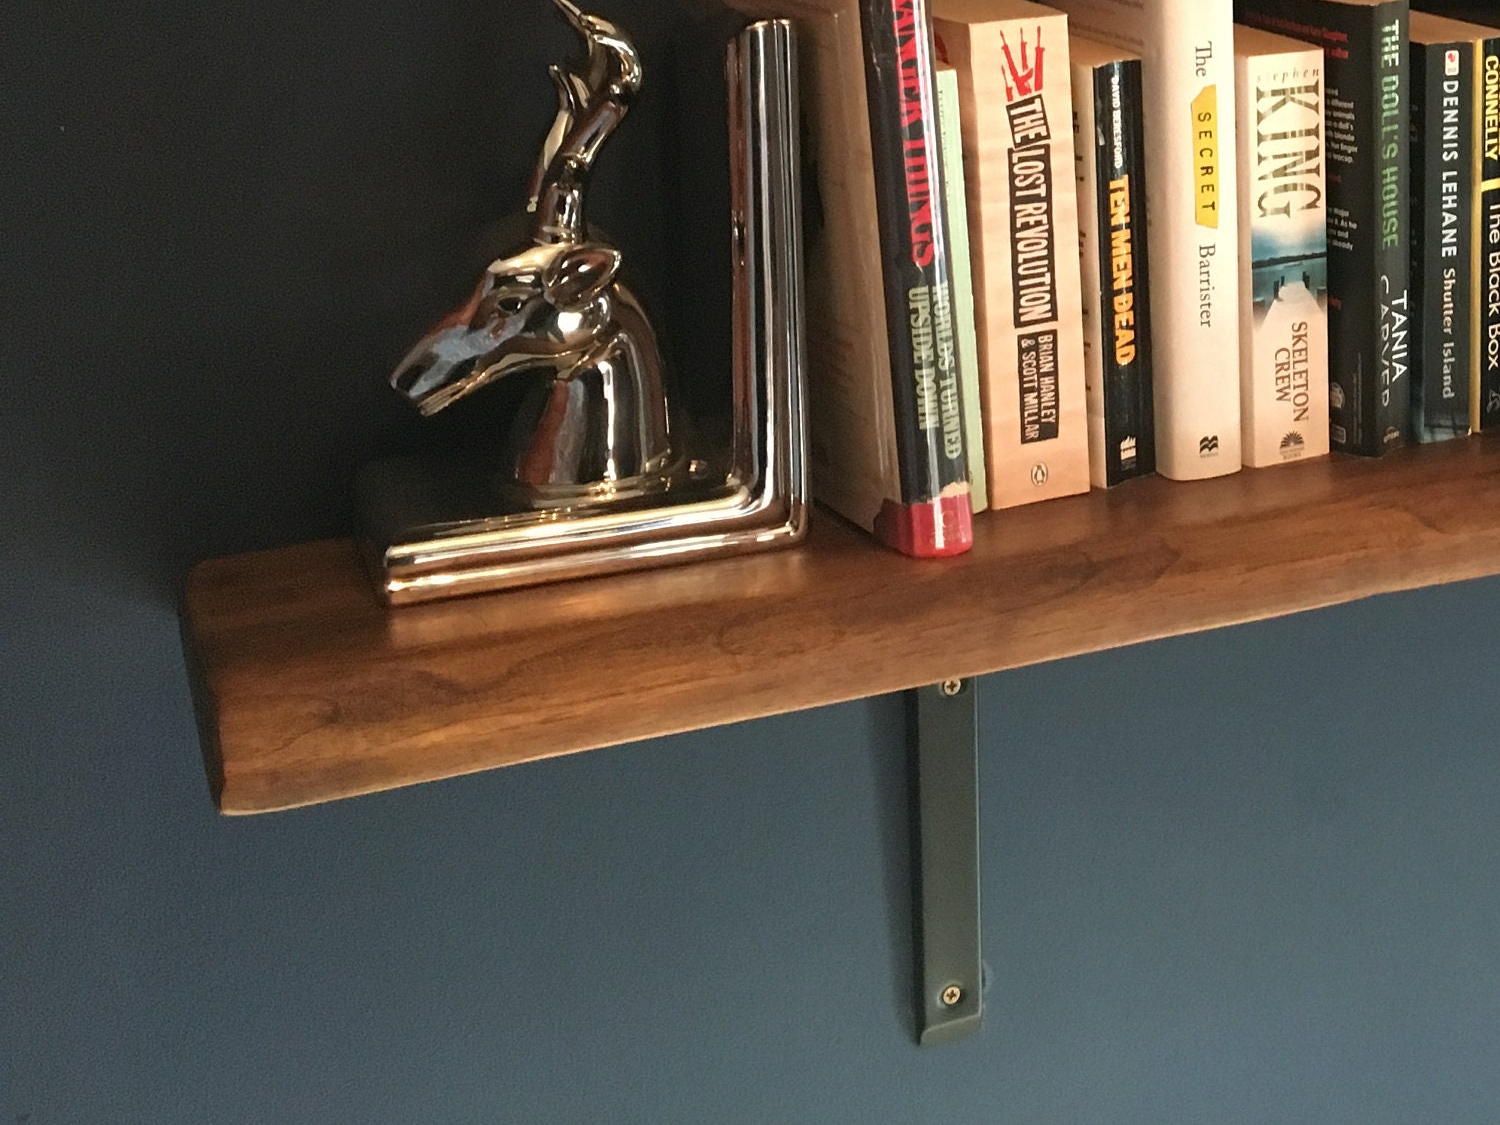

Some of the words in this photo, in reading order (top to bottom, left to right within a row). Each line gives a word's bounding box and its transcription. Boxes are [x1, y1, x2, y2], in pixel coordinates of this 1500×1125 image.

[1195, 41, 1213, 78] The
[1381, 19, 1400, 69] THE
[1011, 98, 1048, 145] THE
[1110, 74, 1123, 108] DAVID
[1381, 75, 1400, 161] DOLL'S
[1442, 80, 1459, 162] DENNIS
[1484, 54, 1499, 162] CONNELLY
[1011, 146, 1047, 198] LOST
[1197, 111, 1216, 212] SECRET
[1255, 78, 1323, 219] KING
[902, 138, 935, 268] THINGS
[1109, 174, 1131, 228] TEN
[1381, 166, 1399, 251] HOUSE
[1441, 170, 1459, 258] LEHANE
[1014, 203, 1053, 323] REVOLUTION
[1111, 228, 1134, 289] MEN
[1199, 243, 1217, 328] Barrister
[908, 284, 934, 365] UPSIDE
[931, 280, 955, 372] WORLDS
[1114, 290, 1137, 367] DEAD
[1391, 289, 1408, 383] TANIA
[1442, 267, 1457, 335] Shutter
[1021, 338, 1031, 349] &
[1021, 351, 1037, 389] SCOTT
[1037, 334, 1054, 373] BRIAN
[1274, 346, 1292, 404] CREW
[1291, 321, 1309, 422] SKELETON
[1442, 342, 1456, 399] Island
[916, 368, 940, 431] DOWN
[941, 376, 963, 460] TURNED
[1023, 392, 1040, 441] MILLAR
[1040, 376, 1056, 424] HANLEY
